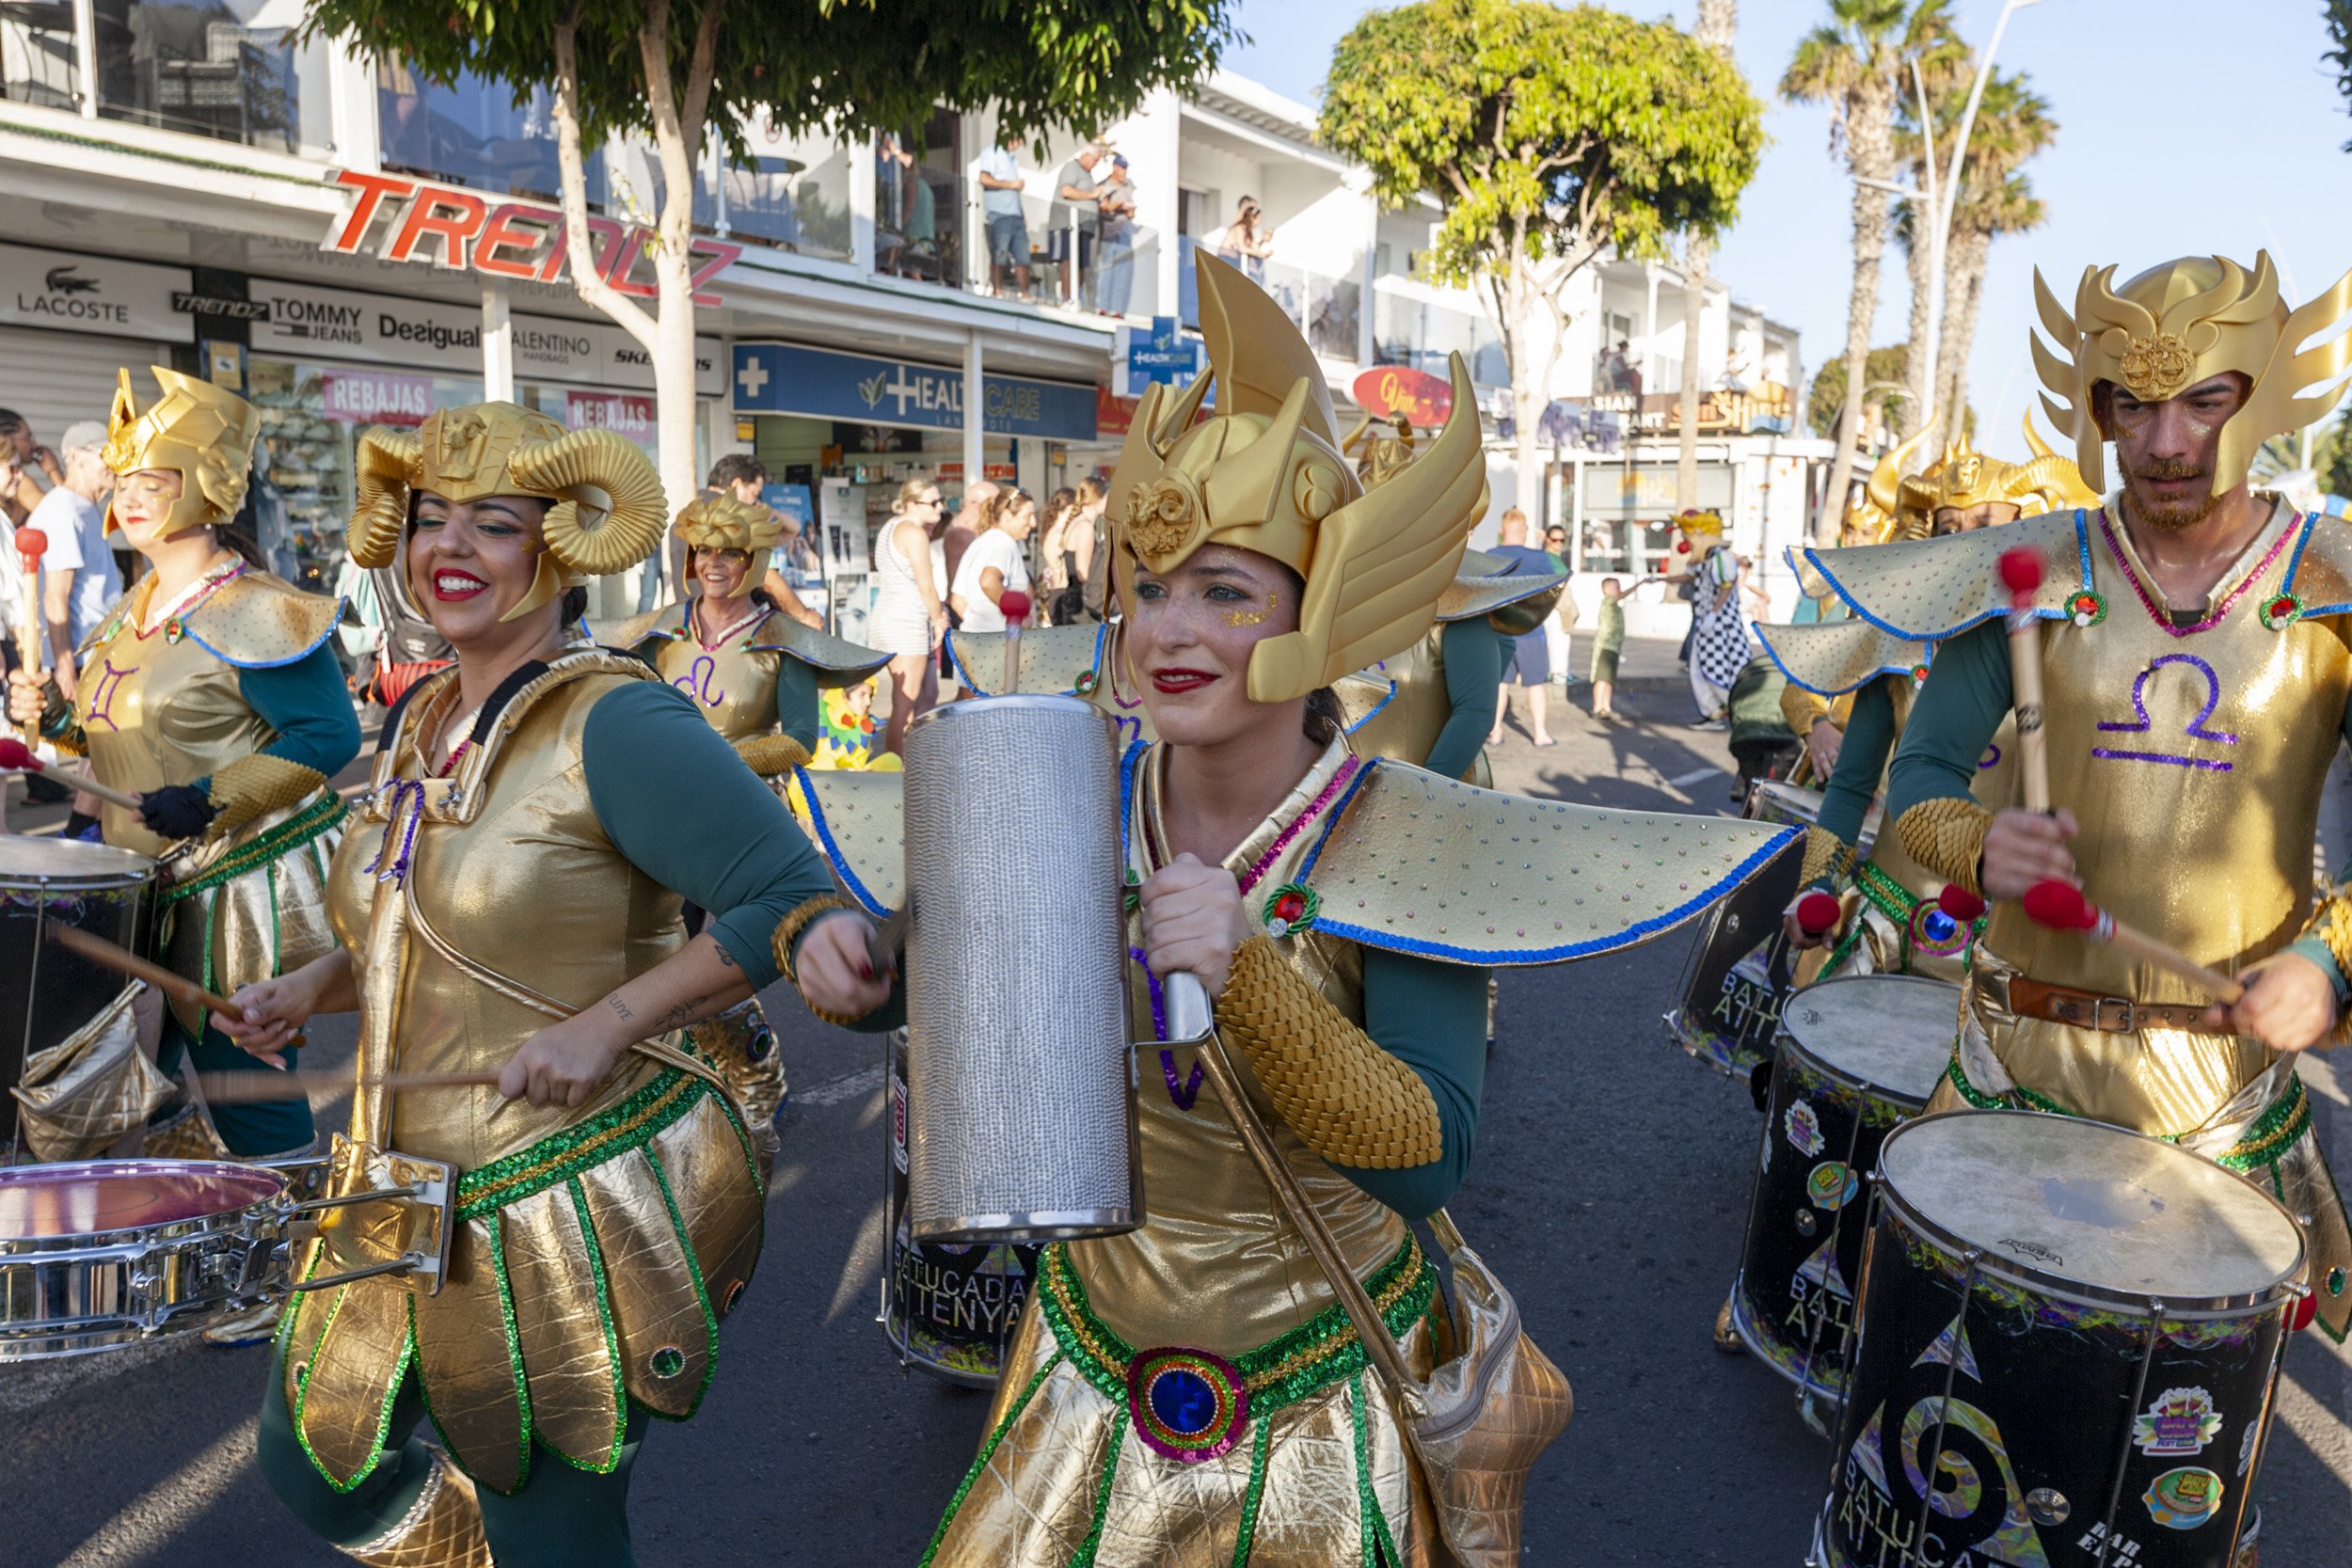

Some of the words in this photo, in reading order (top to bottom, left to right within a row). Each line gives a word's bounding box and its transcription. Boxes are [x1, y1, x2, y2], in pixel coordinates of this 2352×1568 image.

[18, 293, 129, 323] LACOSTE
[176, 293, 267, 319] TRENDZ
[272, 297, 362, 326] TOMMY
[310, 325, 362, 344] JEANS
[379, 313, 480, 349] Desigual
[511, 331, 591, 356] ALENTINO
[523, 351, 569, 365] HANDBAGS
[334, 378, 426, 415] REBAJAS
[573, 399, 647, 433] REBAJAS
